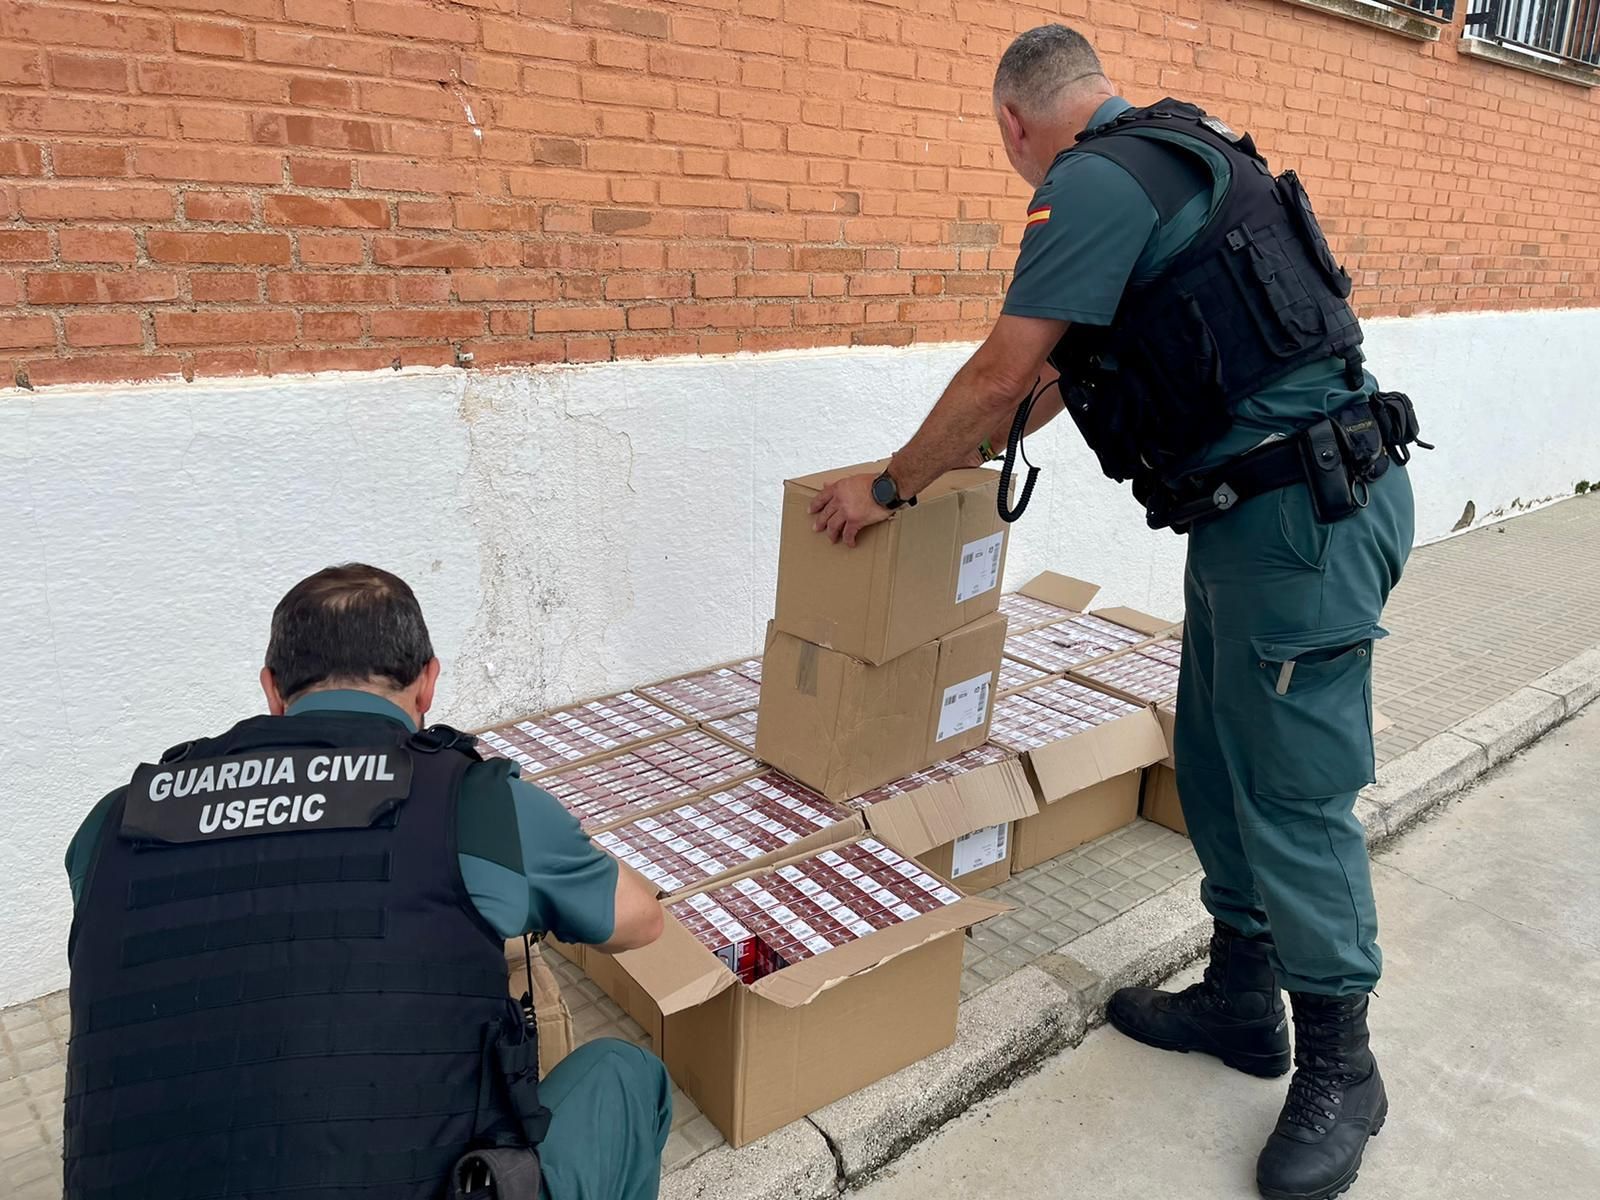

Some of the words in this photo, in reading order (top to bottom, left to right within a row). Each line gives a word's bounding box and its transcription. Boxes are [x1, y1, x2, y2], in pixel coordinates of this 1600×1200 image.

[148, 756, 296, 802] GUARDIA
[306, 754, 395, 783] CIVIL
[198, 793, 327, 834] USECIC
